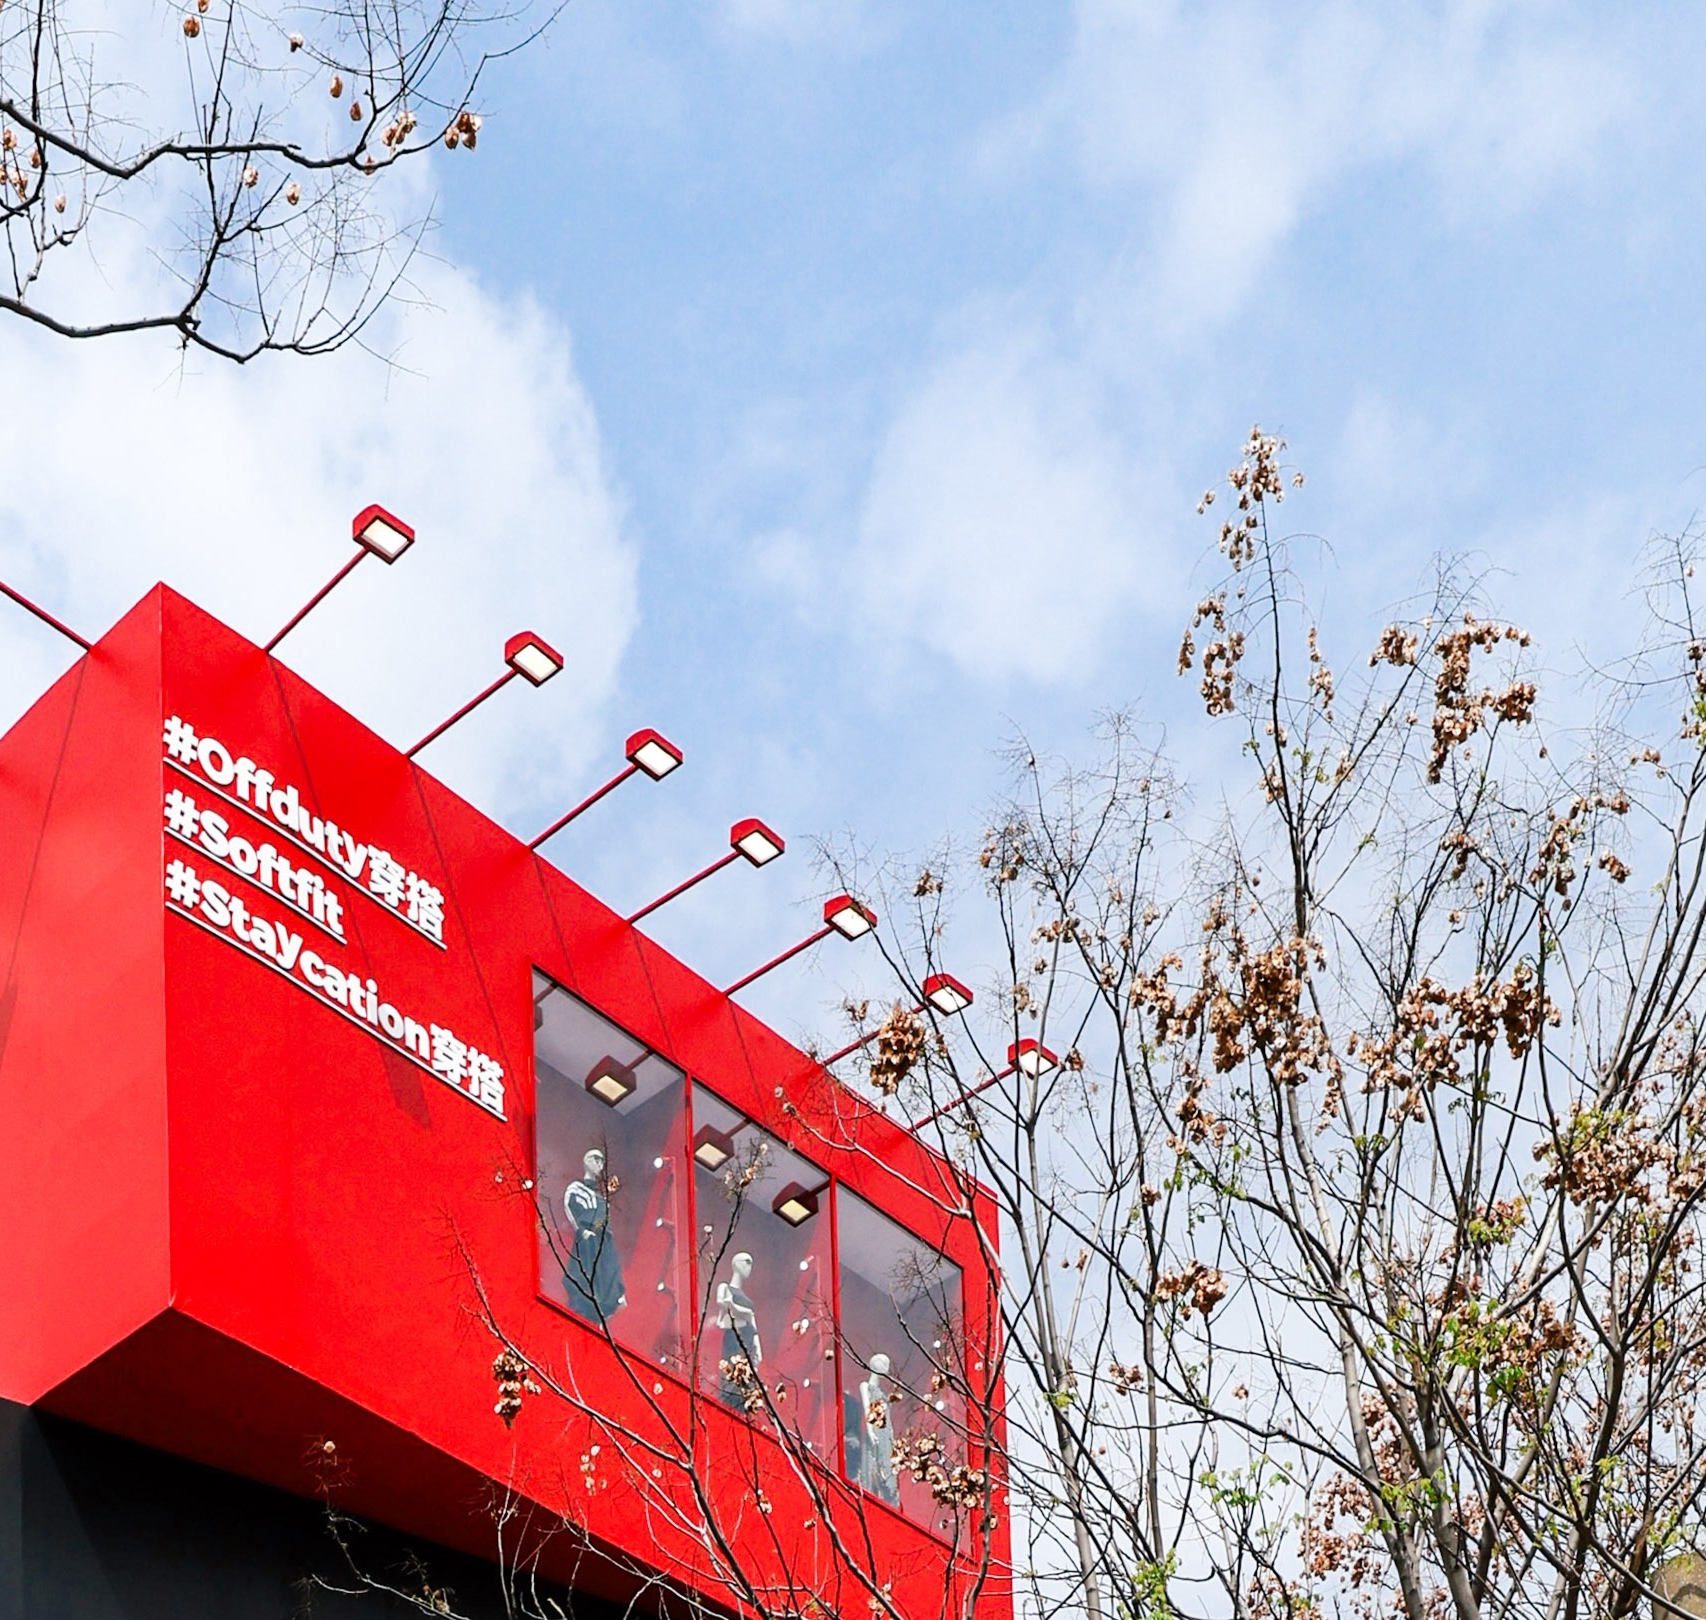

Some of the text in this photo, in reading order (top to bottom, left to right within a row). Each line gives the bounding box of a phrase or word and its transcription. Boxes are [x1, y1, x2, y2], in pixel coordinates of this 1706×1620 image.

[163, 715, 446, 940] #Offduty穿搭
[164, 789, 344, 935] #Softfit
[165, 859, 506, 1114] #Staycation穿搭
